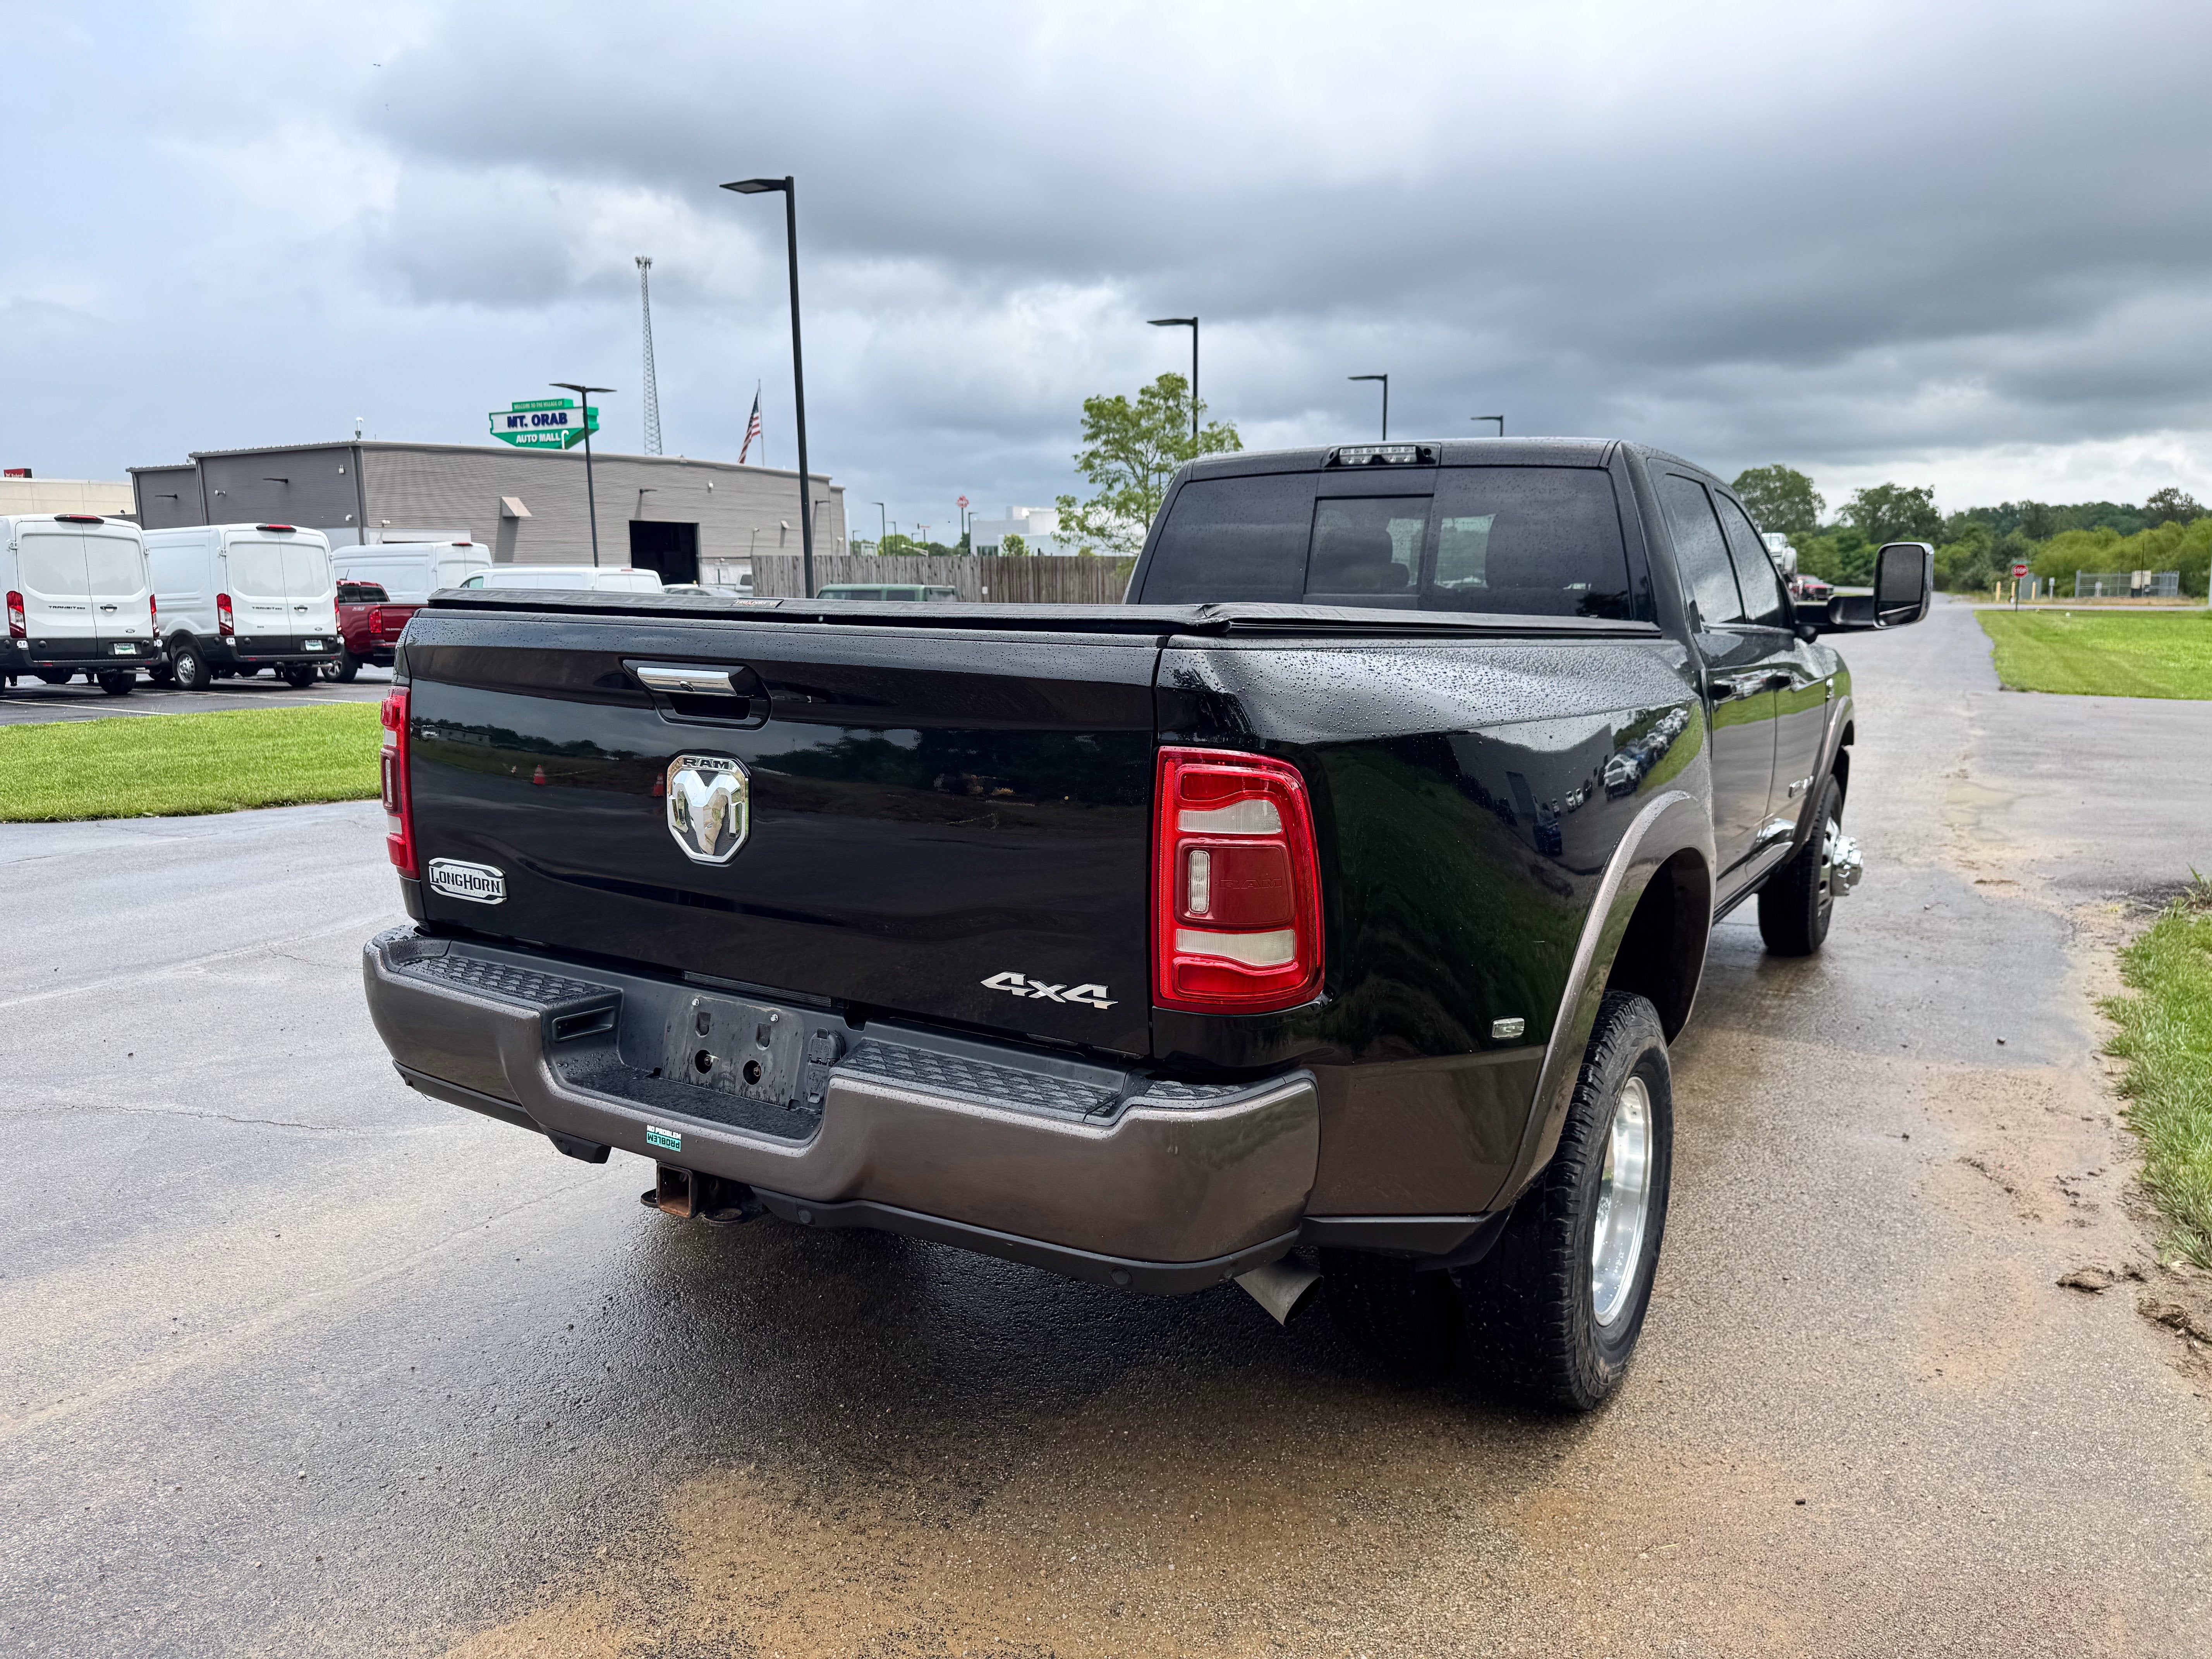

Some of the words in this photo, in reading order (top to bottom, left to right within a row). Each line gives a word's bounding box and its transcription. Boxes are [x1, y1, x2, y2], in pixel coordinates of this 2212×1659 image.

[507, 415, 527, 428] MT.
[531, 412, 568, 426] ORAB
[516, 433, 537, 443] AUTO
[539, 433, 561, 442] MALL
[683, 758, 729, 769] RAM
[430, 867, 501, 893] LONGHORN
[1219, 878, 1282, 889] RAM
[647, 1124, 655, 1132] NO
[655, 1127, 681, 1140] PROBLEM
[647, 1133, 680, 1149] PROBLEM
